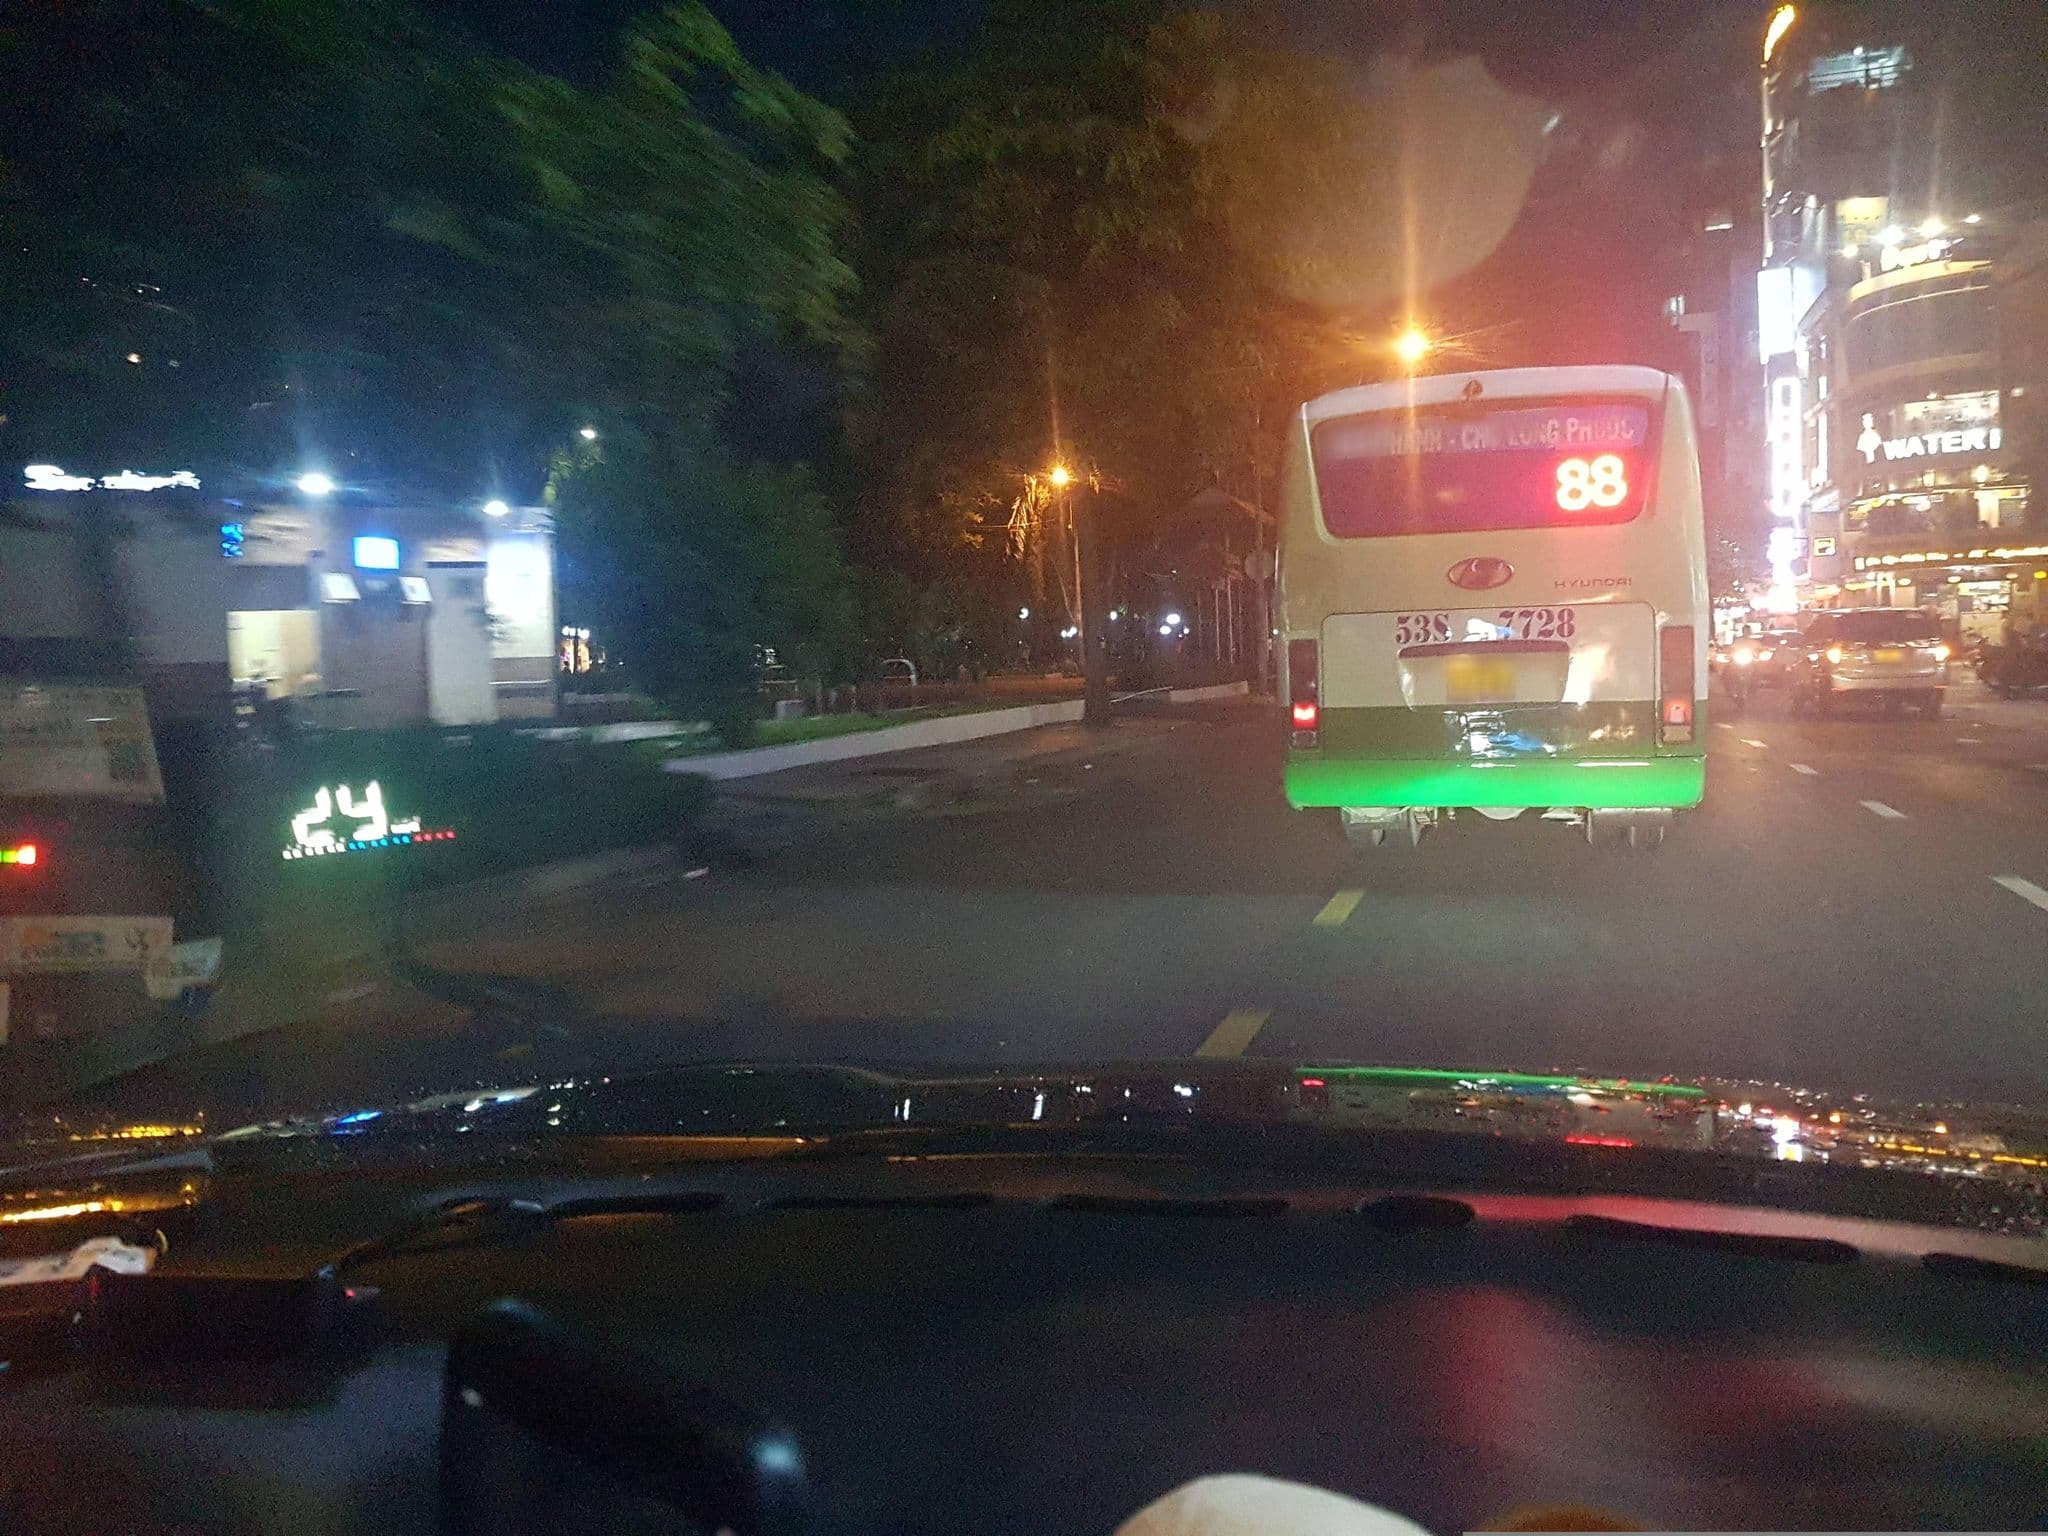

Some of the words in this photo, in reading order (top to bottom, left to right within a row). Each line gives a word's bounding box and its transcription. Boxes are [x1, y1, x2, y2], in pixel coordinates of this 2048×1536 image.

[1555, 454, 1628, 511] 88
[1554, 576, 1632, 588] HYUNDAI
[1395, 613, 1451, 645] 53S
[1498, 608, 1576, 640] 7728
